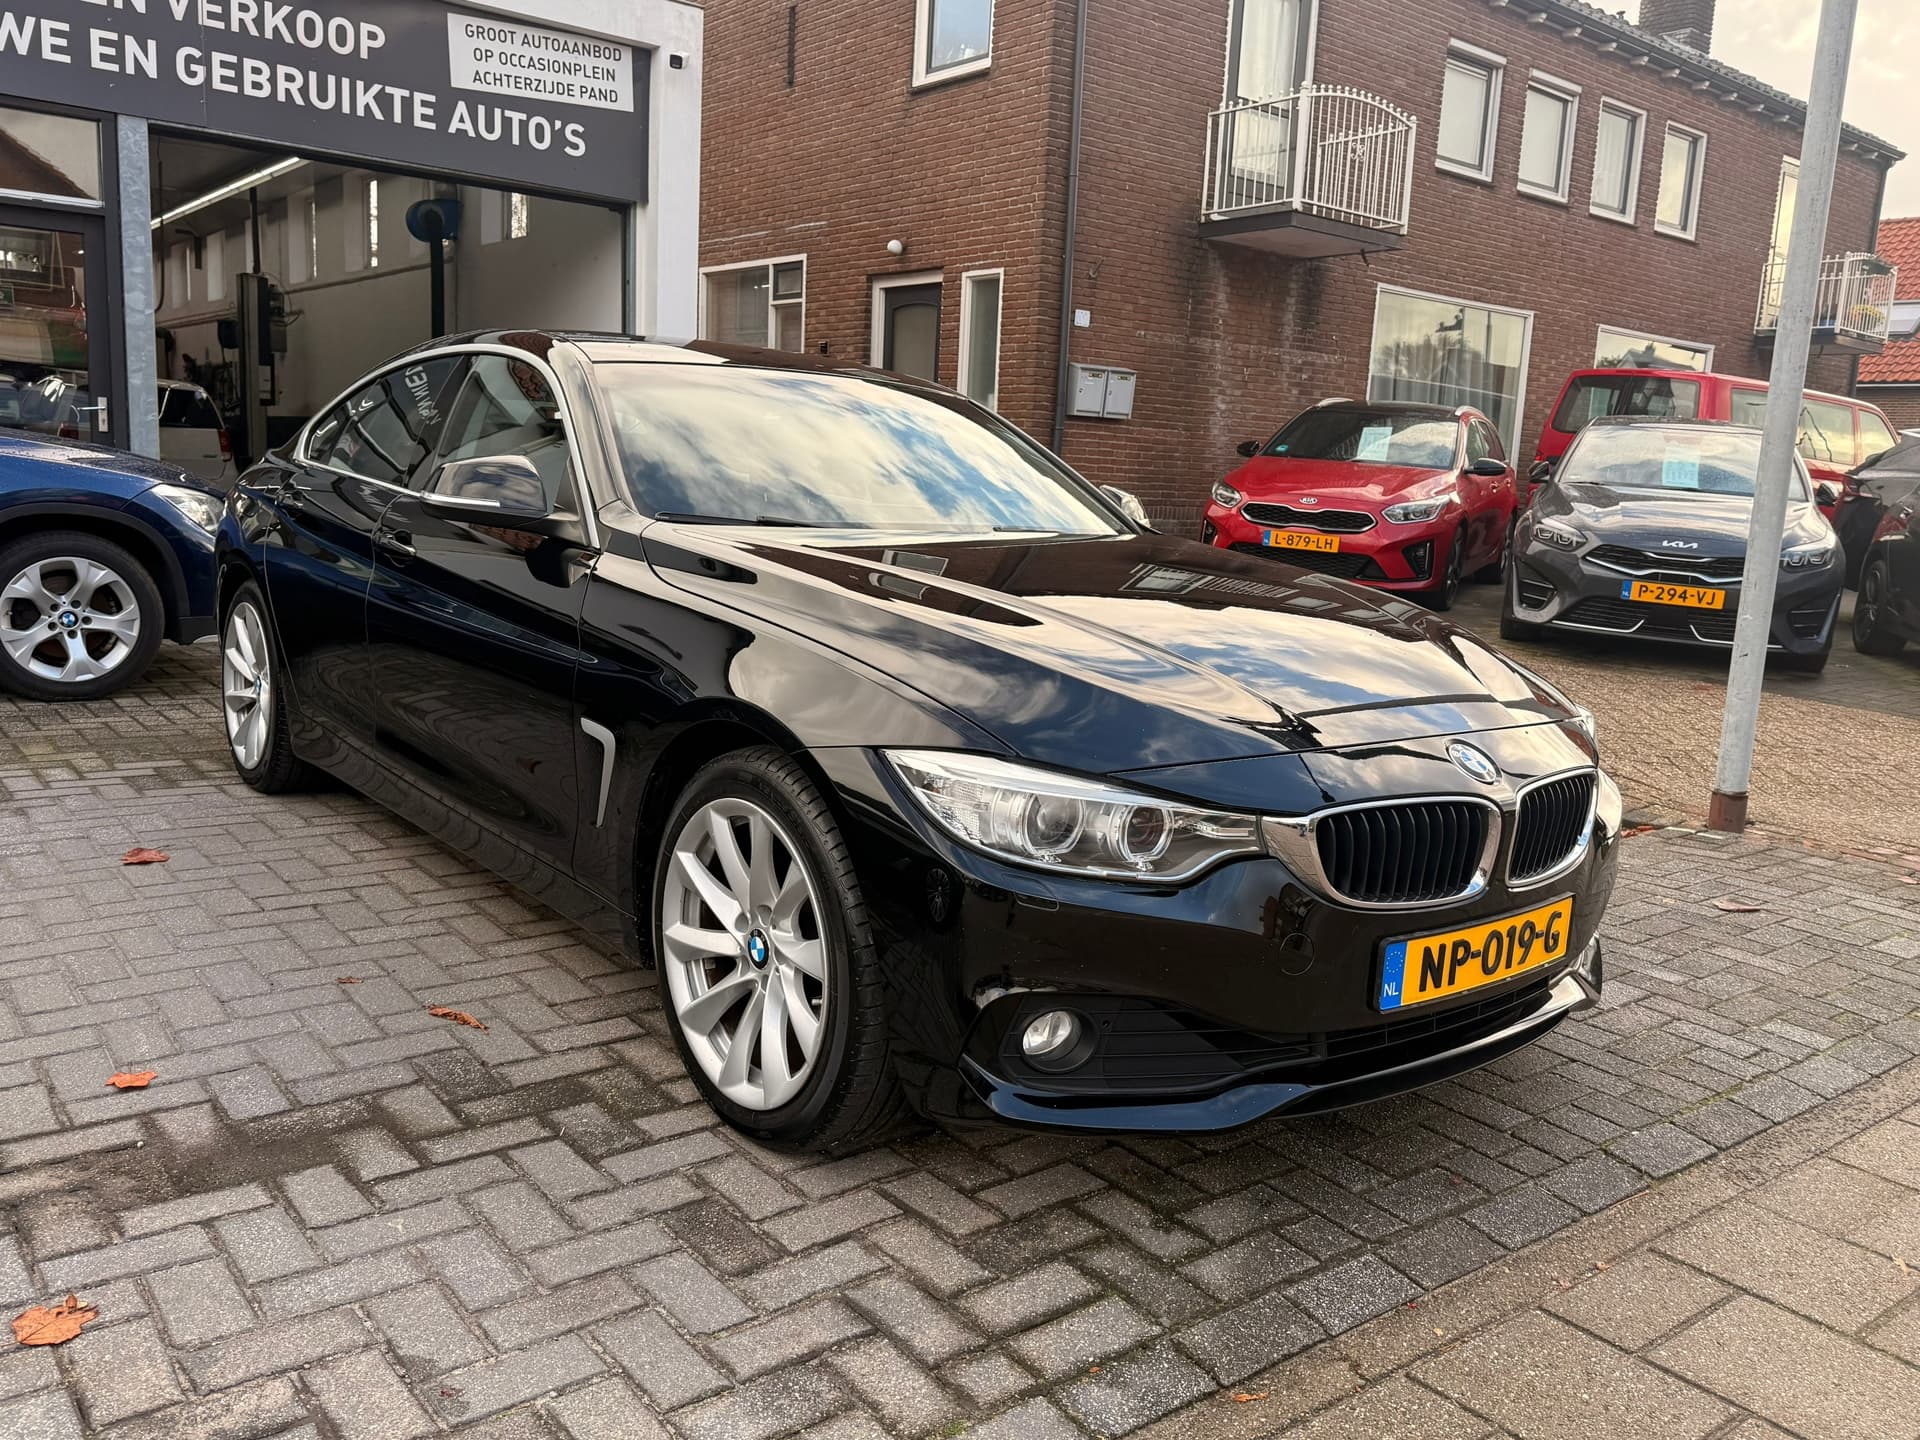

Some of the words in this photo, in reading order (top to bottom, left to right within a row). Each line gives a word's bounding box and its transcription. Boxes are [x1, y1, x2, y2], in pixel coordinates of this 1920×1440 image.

[168, 0, 386, 59] VERKOOP
[465, 24, 517, 45] GROOT
[521, 33, 622, 62] AUTOAANBOD
[473, 48, 494, 63] OP
[499, 52, 616, 82] OCCASIONPLEIN
[90, 28, 158, 79] EN
[176, 46, 436, 130] GEBRUIKTE
[448, 101, 586, 157] AUTO'S
[473, 70, 575, 97] ACHTERZIJDE
[580, 85, 618, 103] PAND
[1274, 533, 1333, 550] L-879-LH
[1638, 584, 1716, 606] P-294-VJ
[1419, 911, 1562, 992] NP-019-G
[1384, 982, 1399, 997] NL
